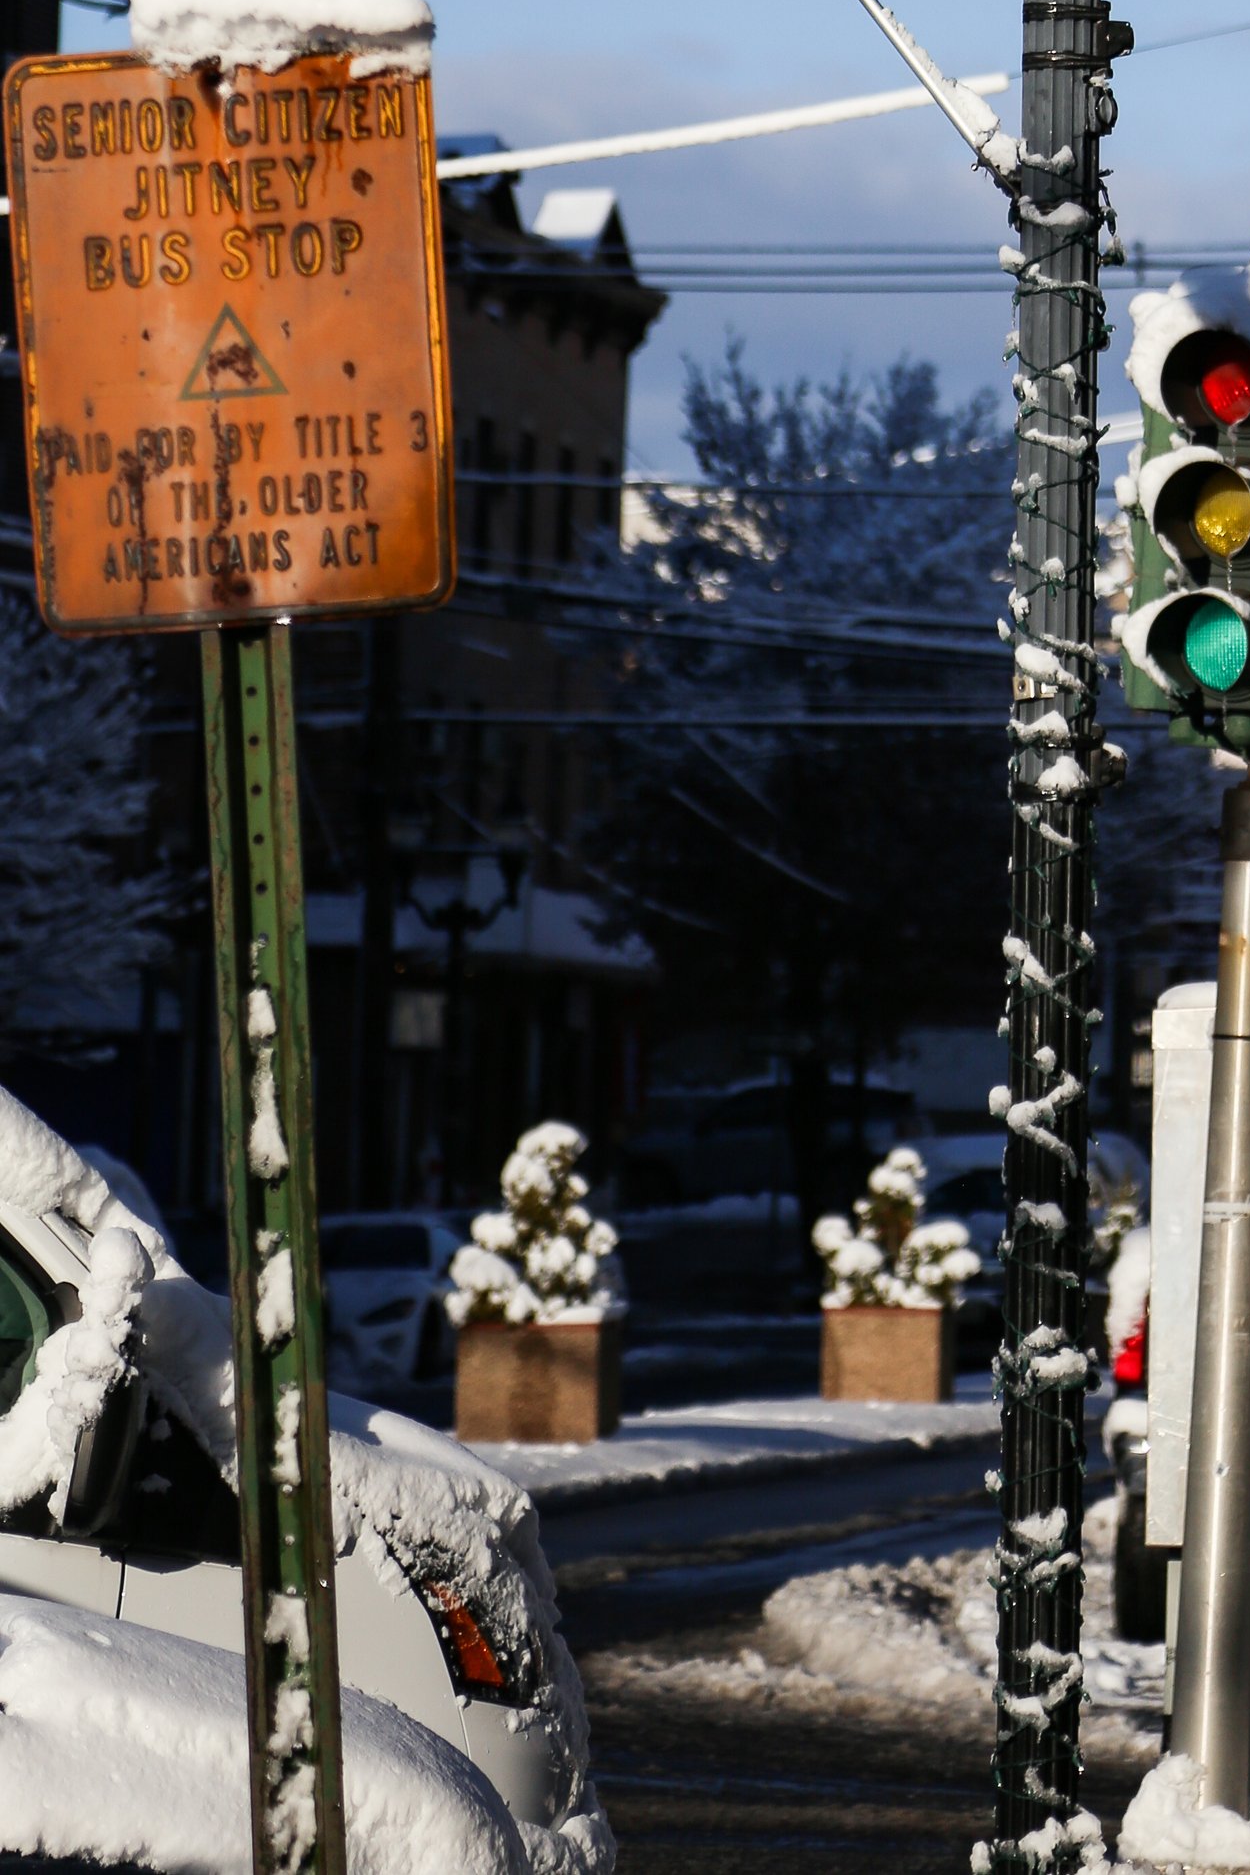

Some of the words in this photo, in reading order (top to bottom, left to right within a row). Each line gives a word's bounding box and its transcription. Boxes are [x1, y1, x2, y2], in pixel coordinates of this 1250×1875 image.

[32, 95, 197, 162] SENIOR
[224, 84, 405, 147] CITIZEN
[123, 155, 318, 222] JITNEY
[83, 230, 193, 293] BUS
[220, 218, 363, 282] STOP
[45, 428, 113, 477] PAID
[135, 426, 197, 470] FOR
[222, 422, 266, 465] BY
[294, 411, 384, 459] TITLE
[409, 409, 429, 453] 3
[169, 477, 233, 524] THE
[258, 470, 369, 517] OLDER
[102, 528, 292, 583] AMERICANS
[319, 519, 381, 569] ACT
